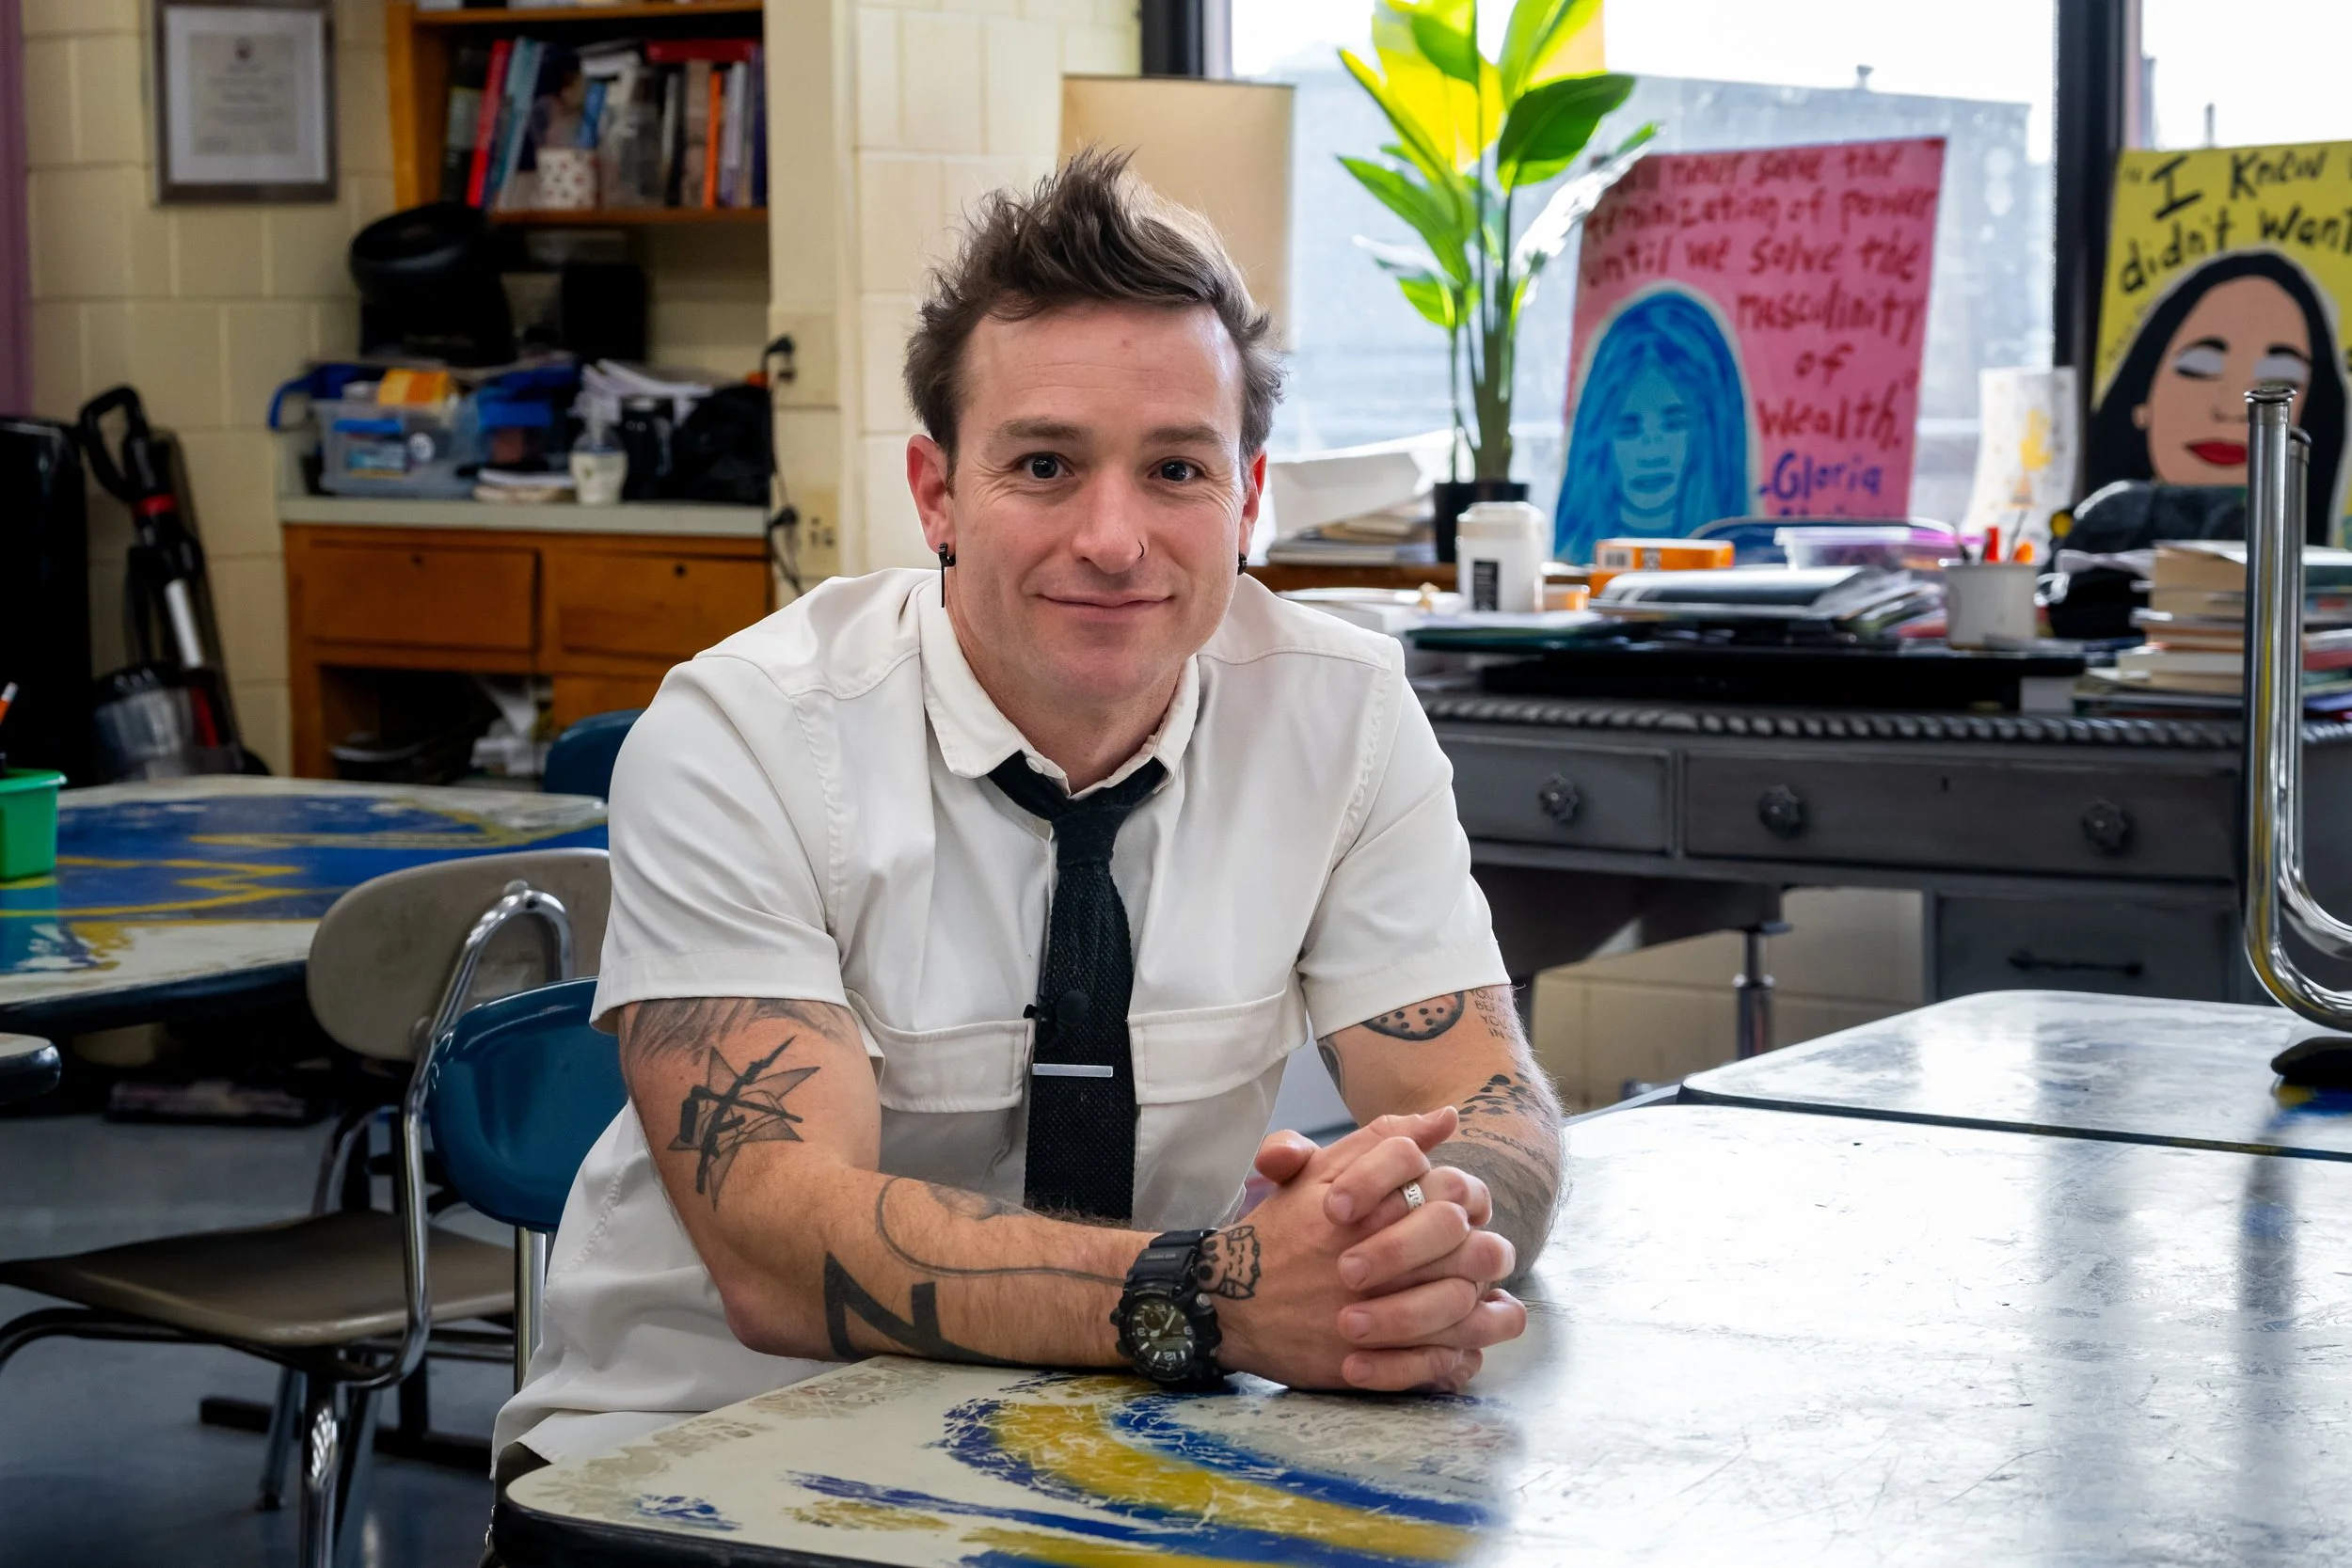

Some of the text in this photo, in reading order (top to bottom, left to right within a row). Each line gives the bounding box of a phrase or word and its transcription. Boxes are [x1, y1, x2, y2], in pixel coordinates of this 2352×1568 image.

[1749, 235, 1843, 275] solve
[1856, 227, 1923, 282] the
[1794, 342, 1854, 388] of
[1163, 1352, 1177, 1362] 12
